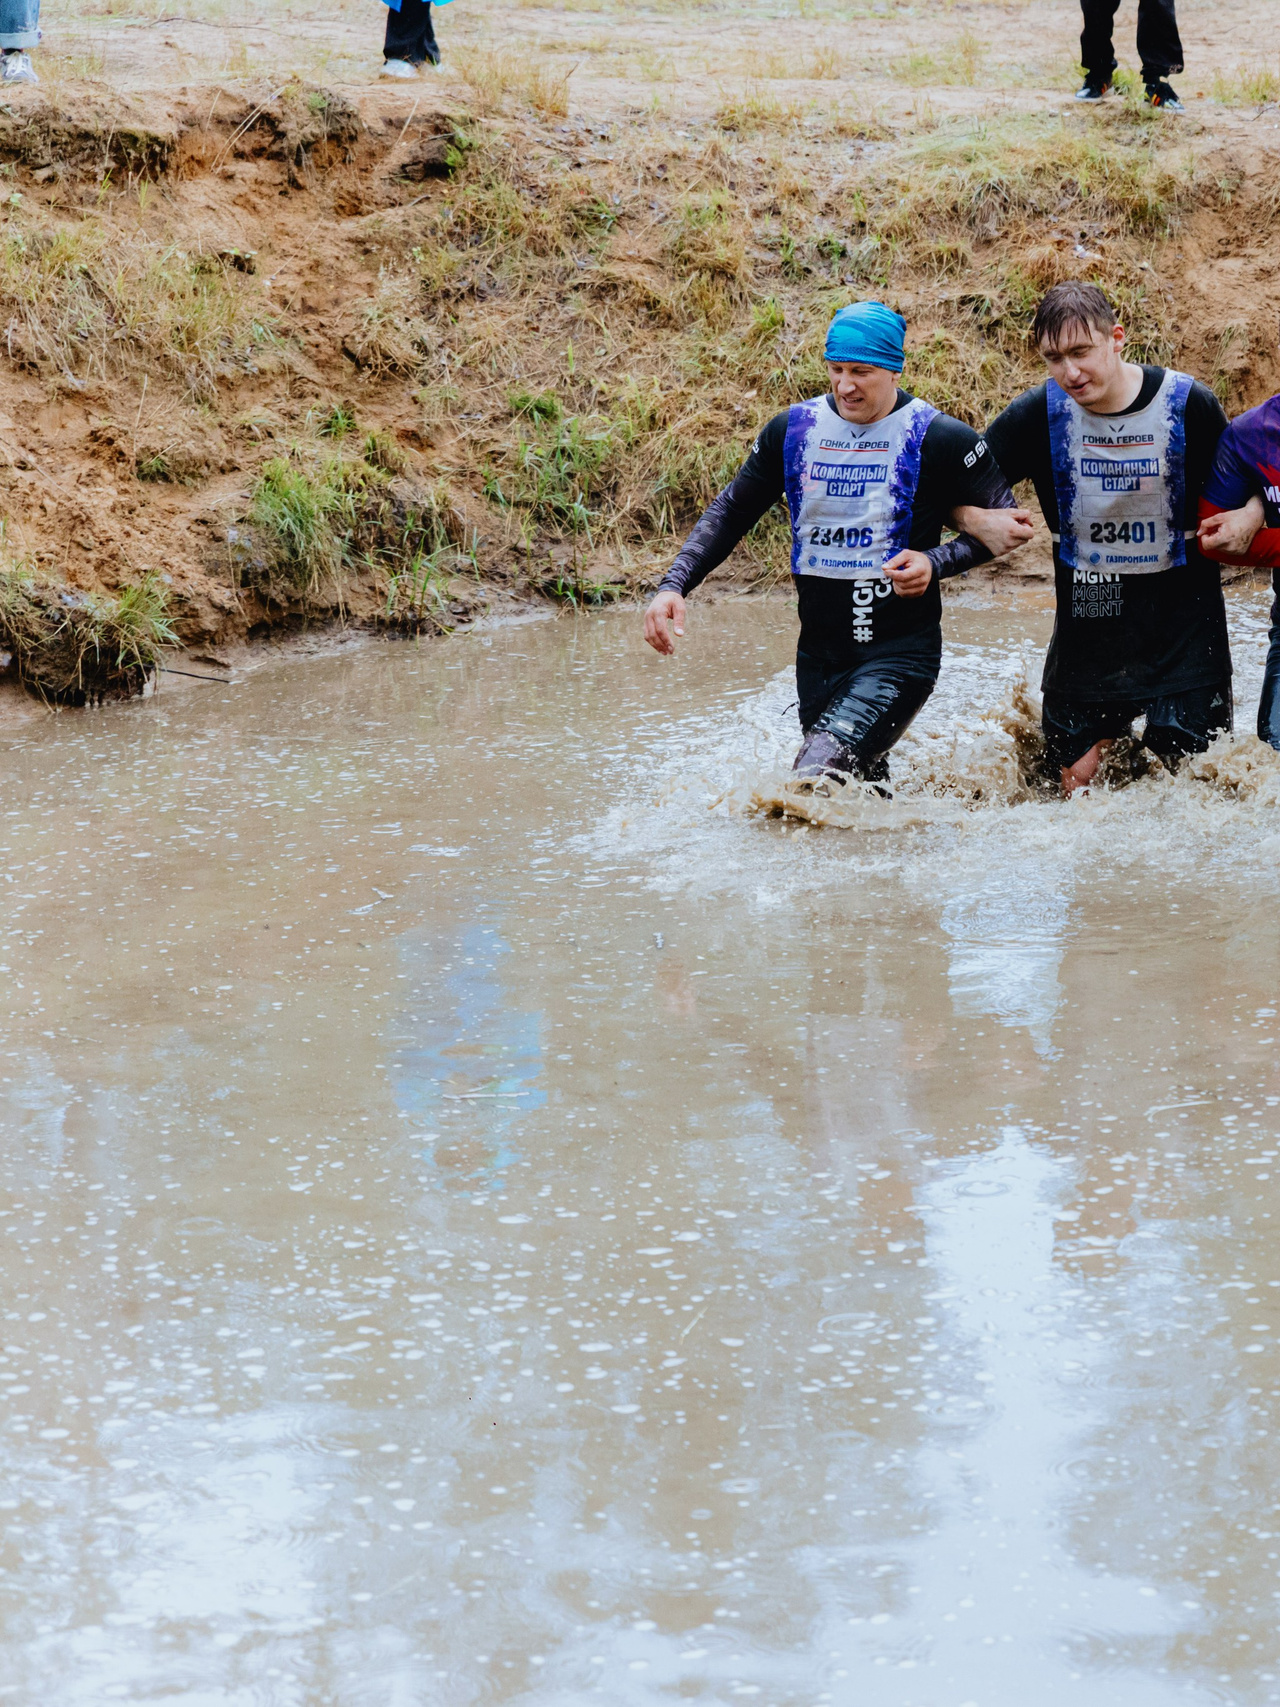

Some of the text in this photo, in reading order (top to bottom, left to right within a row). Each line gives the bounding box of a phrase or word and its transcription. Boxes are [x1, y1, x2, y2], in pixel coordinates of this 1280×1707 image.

[819, 438, 890, 449] ГОНКА ГЕРОЕВ
[1082, 434, 1155, 445] ГОНКА ГЕРОЕВ
[812, 463, 888, 484] КОМАНДНЫЙ
[1082, 458, 1160, 477] КОМАНДНЫЙ
[829, 481, 865, 497] СТАРТ
[1104, 476, 1139, 491] СТАРТ
[809, 526, 874, 548] 23406
[1089, 521, 1156, 544] 23401
[821, 558, 874, 568] ГАЗПРОМБАНК
[1106, 553, 1159, 564] ГАЗПРОМБАНК
[1072, 583, 1124, 602] MGNT
[1072, 600, 1124, 618] MGNT
